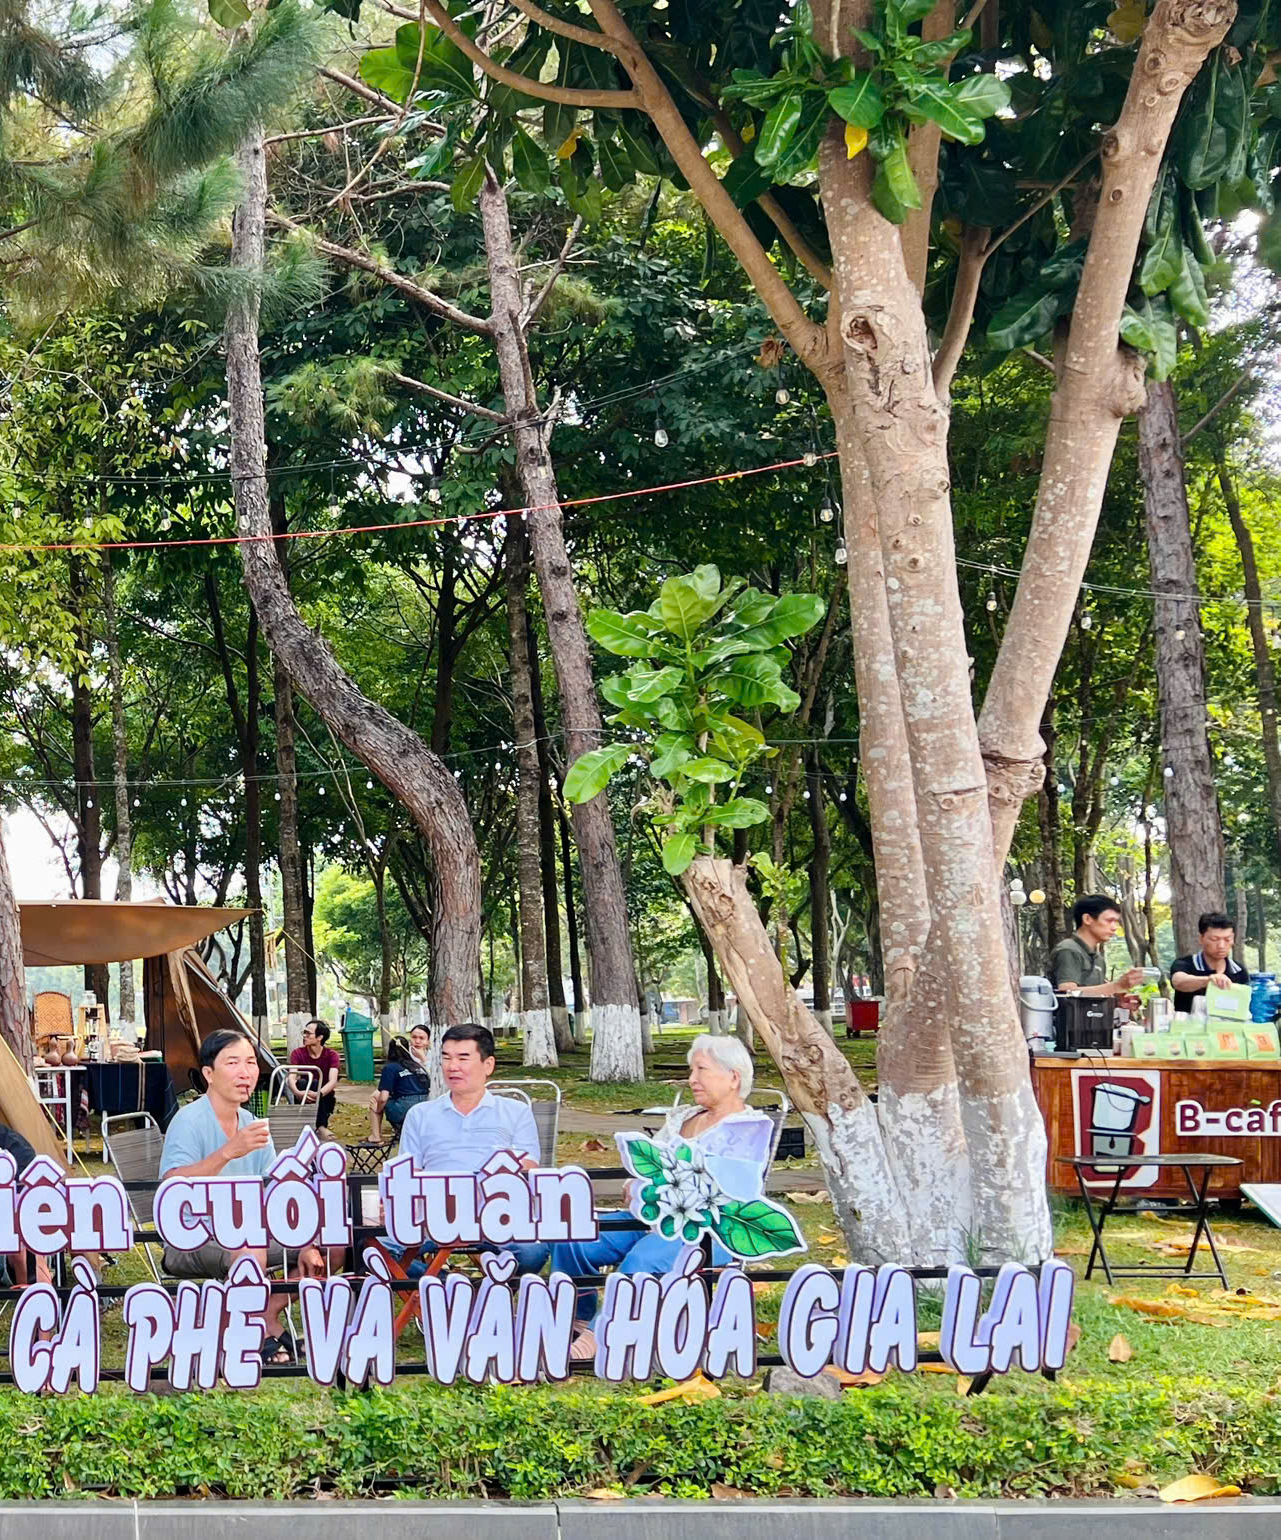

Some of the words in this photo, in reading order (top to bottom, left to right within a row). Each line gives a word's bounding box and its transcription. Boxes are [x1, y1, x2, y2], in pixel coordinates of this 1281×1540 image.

[153, 1126, 353, 1251] cuối
[10, 1256, 99, 1395] CÀ
[124, 1256, 270, 1392] PHÊ
[299, 1248, 396, 1386] VÀ
[419, 1251, 577, 1386] VĂN
[595, 1245, 756, 1382] HÓA
[779, 1263, 918, 1378] GIA
[940, 1259, 1074, 1376] LAI
